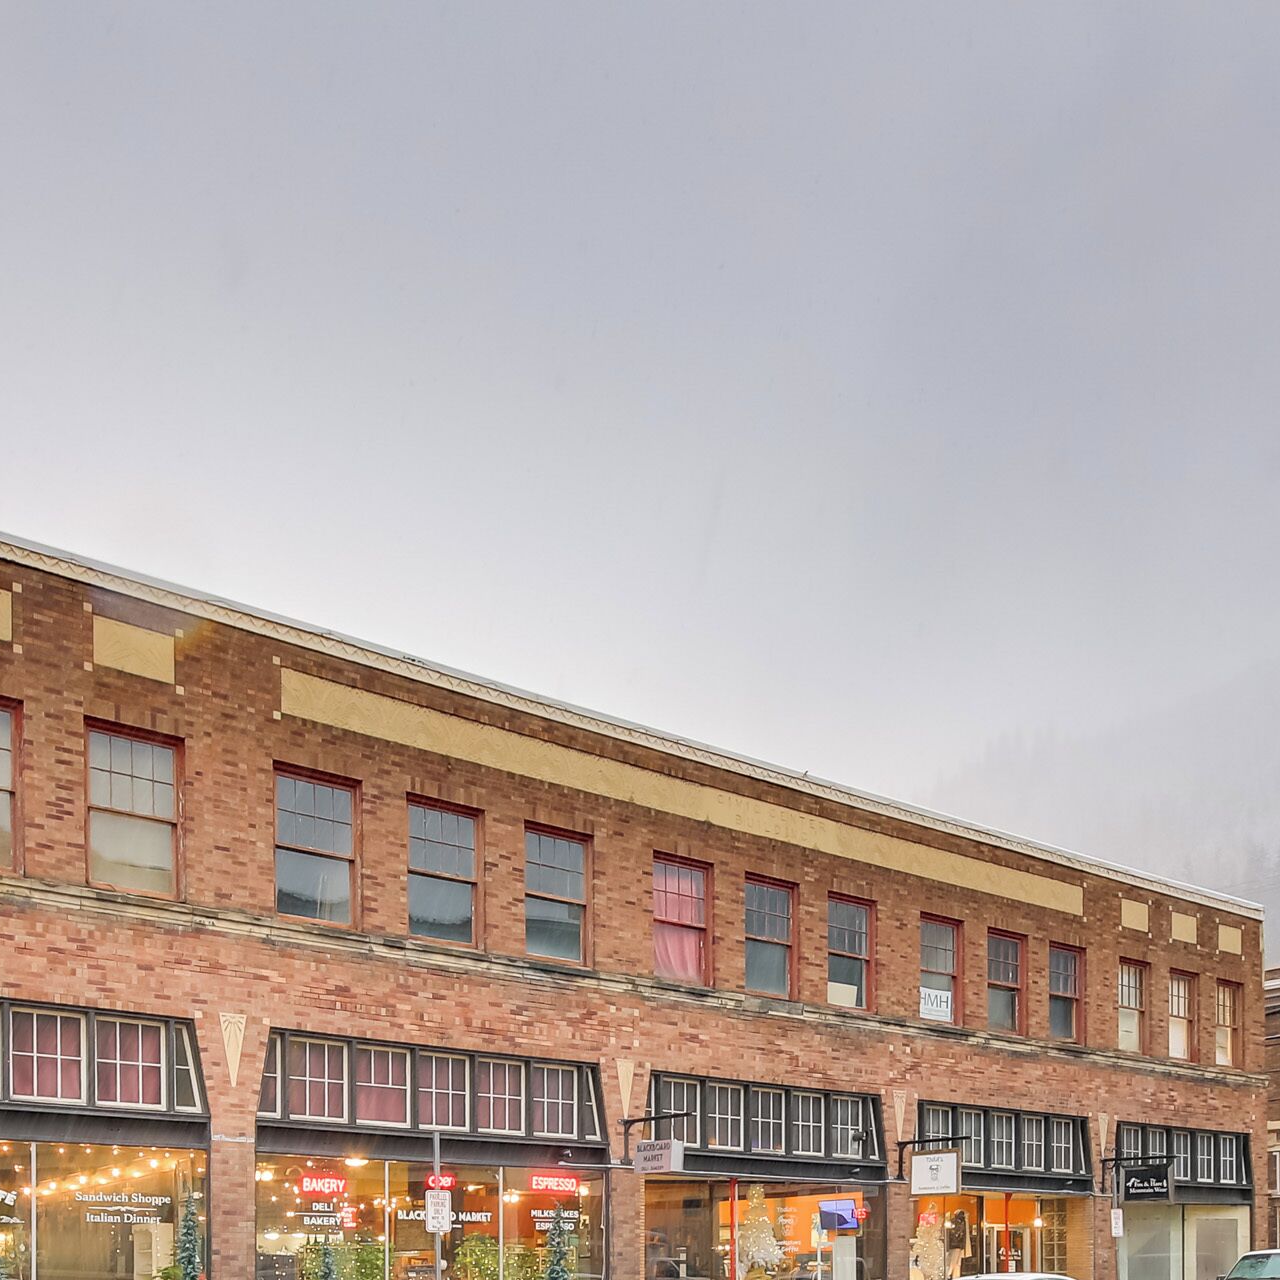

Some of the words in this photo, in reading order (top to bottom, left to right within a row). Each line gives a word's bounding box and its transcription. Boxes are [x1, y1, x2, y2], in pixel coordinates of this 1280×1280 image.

[636, 1142, 671, 1152] BLACKBOARD
[643, 1153, 663, 1162] MARKET
[302, 1177, 346, 1194] BAKERY
[532, 1176, 577, 1192] ESPRESSO
[75, 1191, 129, 1203] Sandwich
[131, 1193, 171, 1207] Shoppe
[312, 1202, 334, 1211] DELI
[85, 1212, 121, 1223] Italian
[123, 1213, 162, 1224] Dinner
[303, 1216, 342, 1226] BAKERY
[459, 1211, 493, 1222] MARKET
